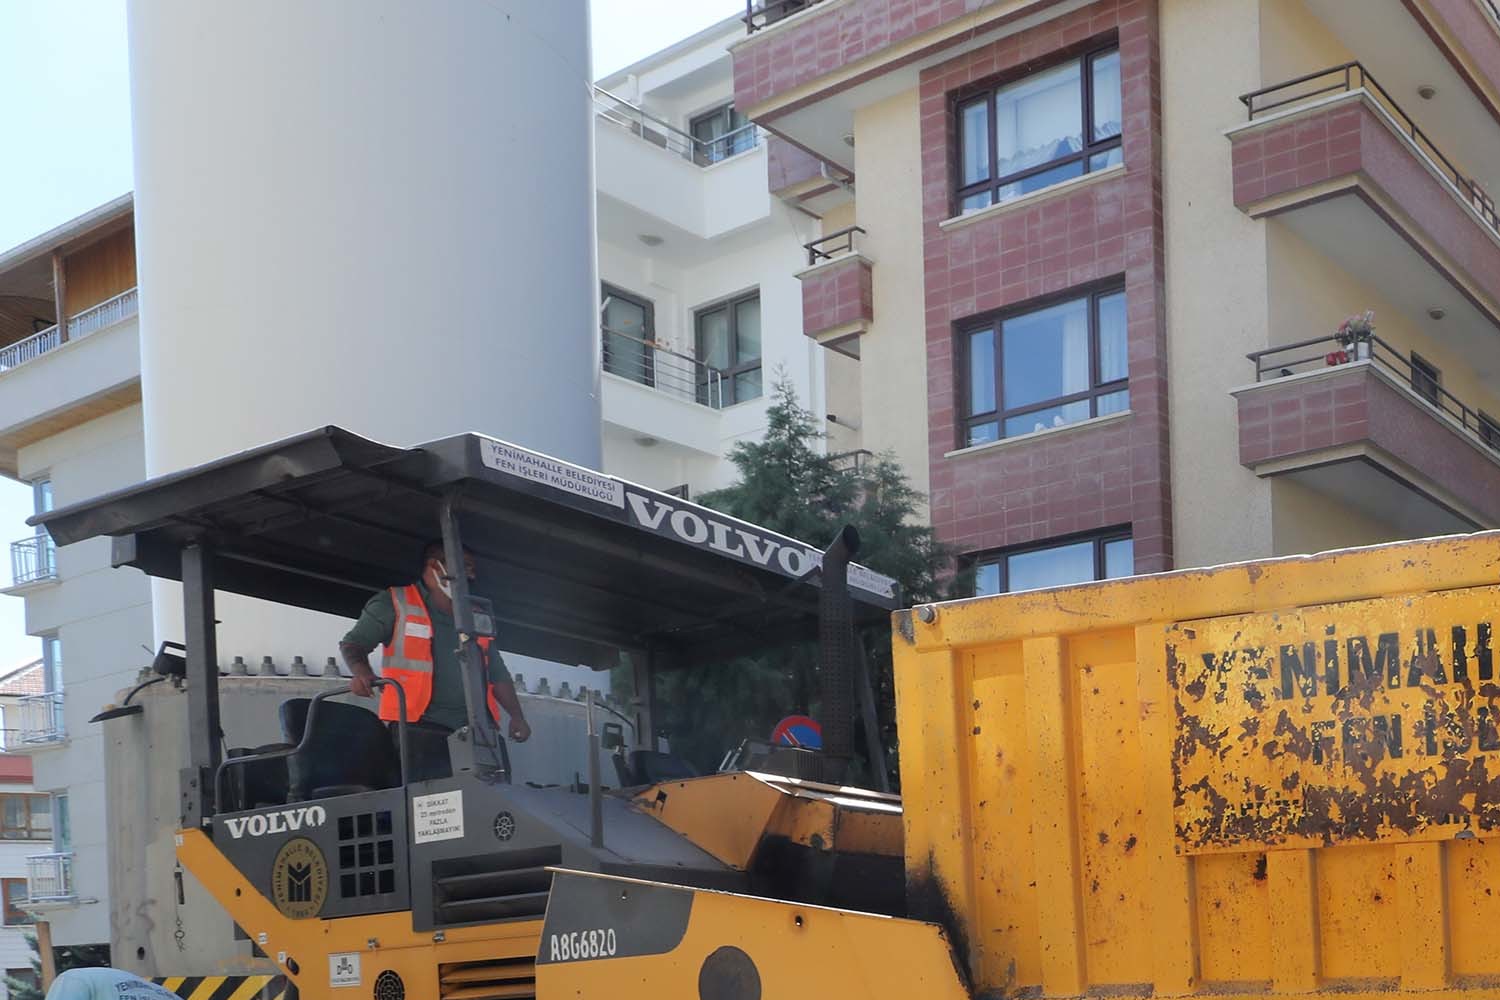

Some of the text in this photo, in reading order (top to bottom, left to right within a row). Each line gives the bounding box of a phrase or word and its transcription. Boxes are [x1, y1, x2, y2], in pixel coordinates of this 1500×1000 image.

[491, 444, 616, 492] YENİMAHALLE BELEDİYESİ
[495, 458, 516, 472] FEN
[625, 491, 807, 577] VOLVO
[224, 806, 327, 839] VOLVO
[551, 928, 616, 961] ABG6820
